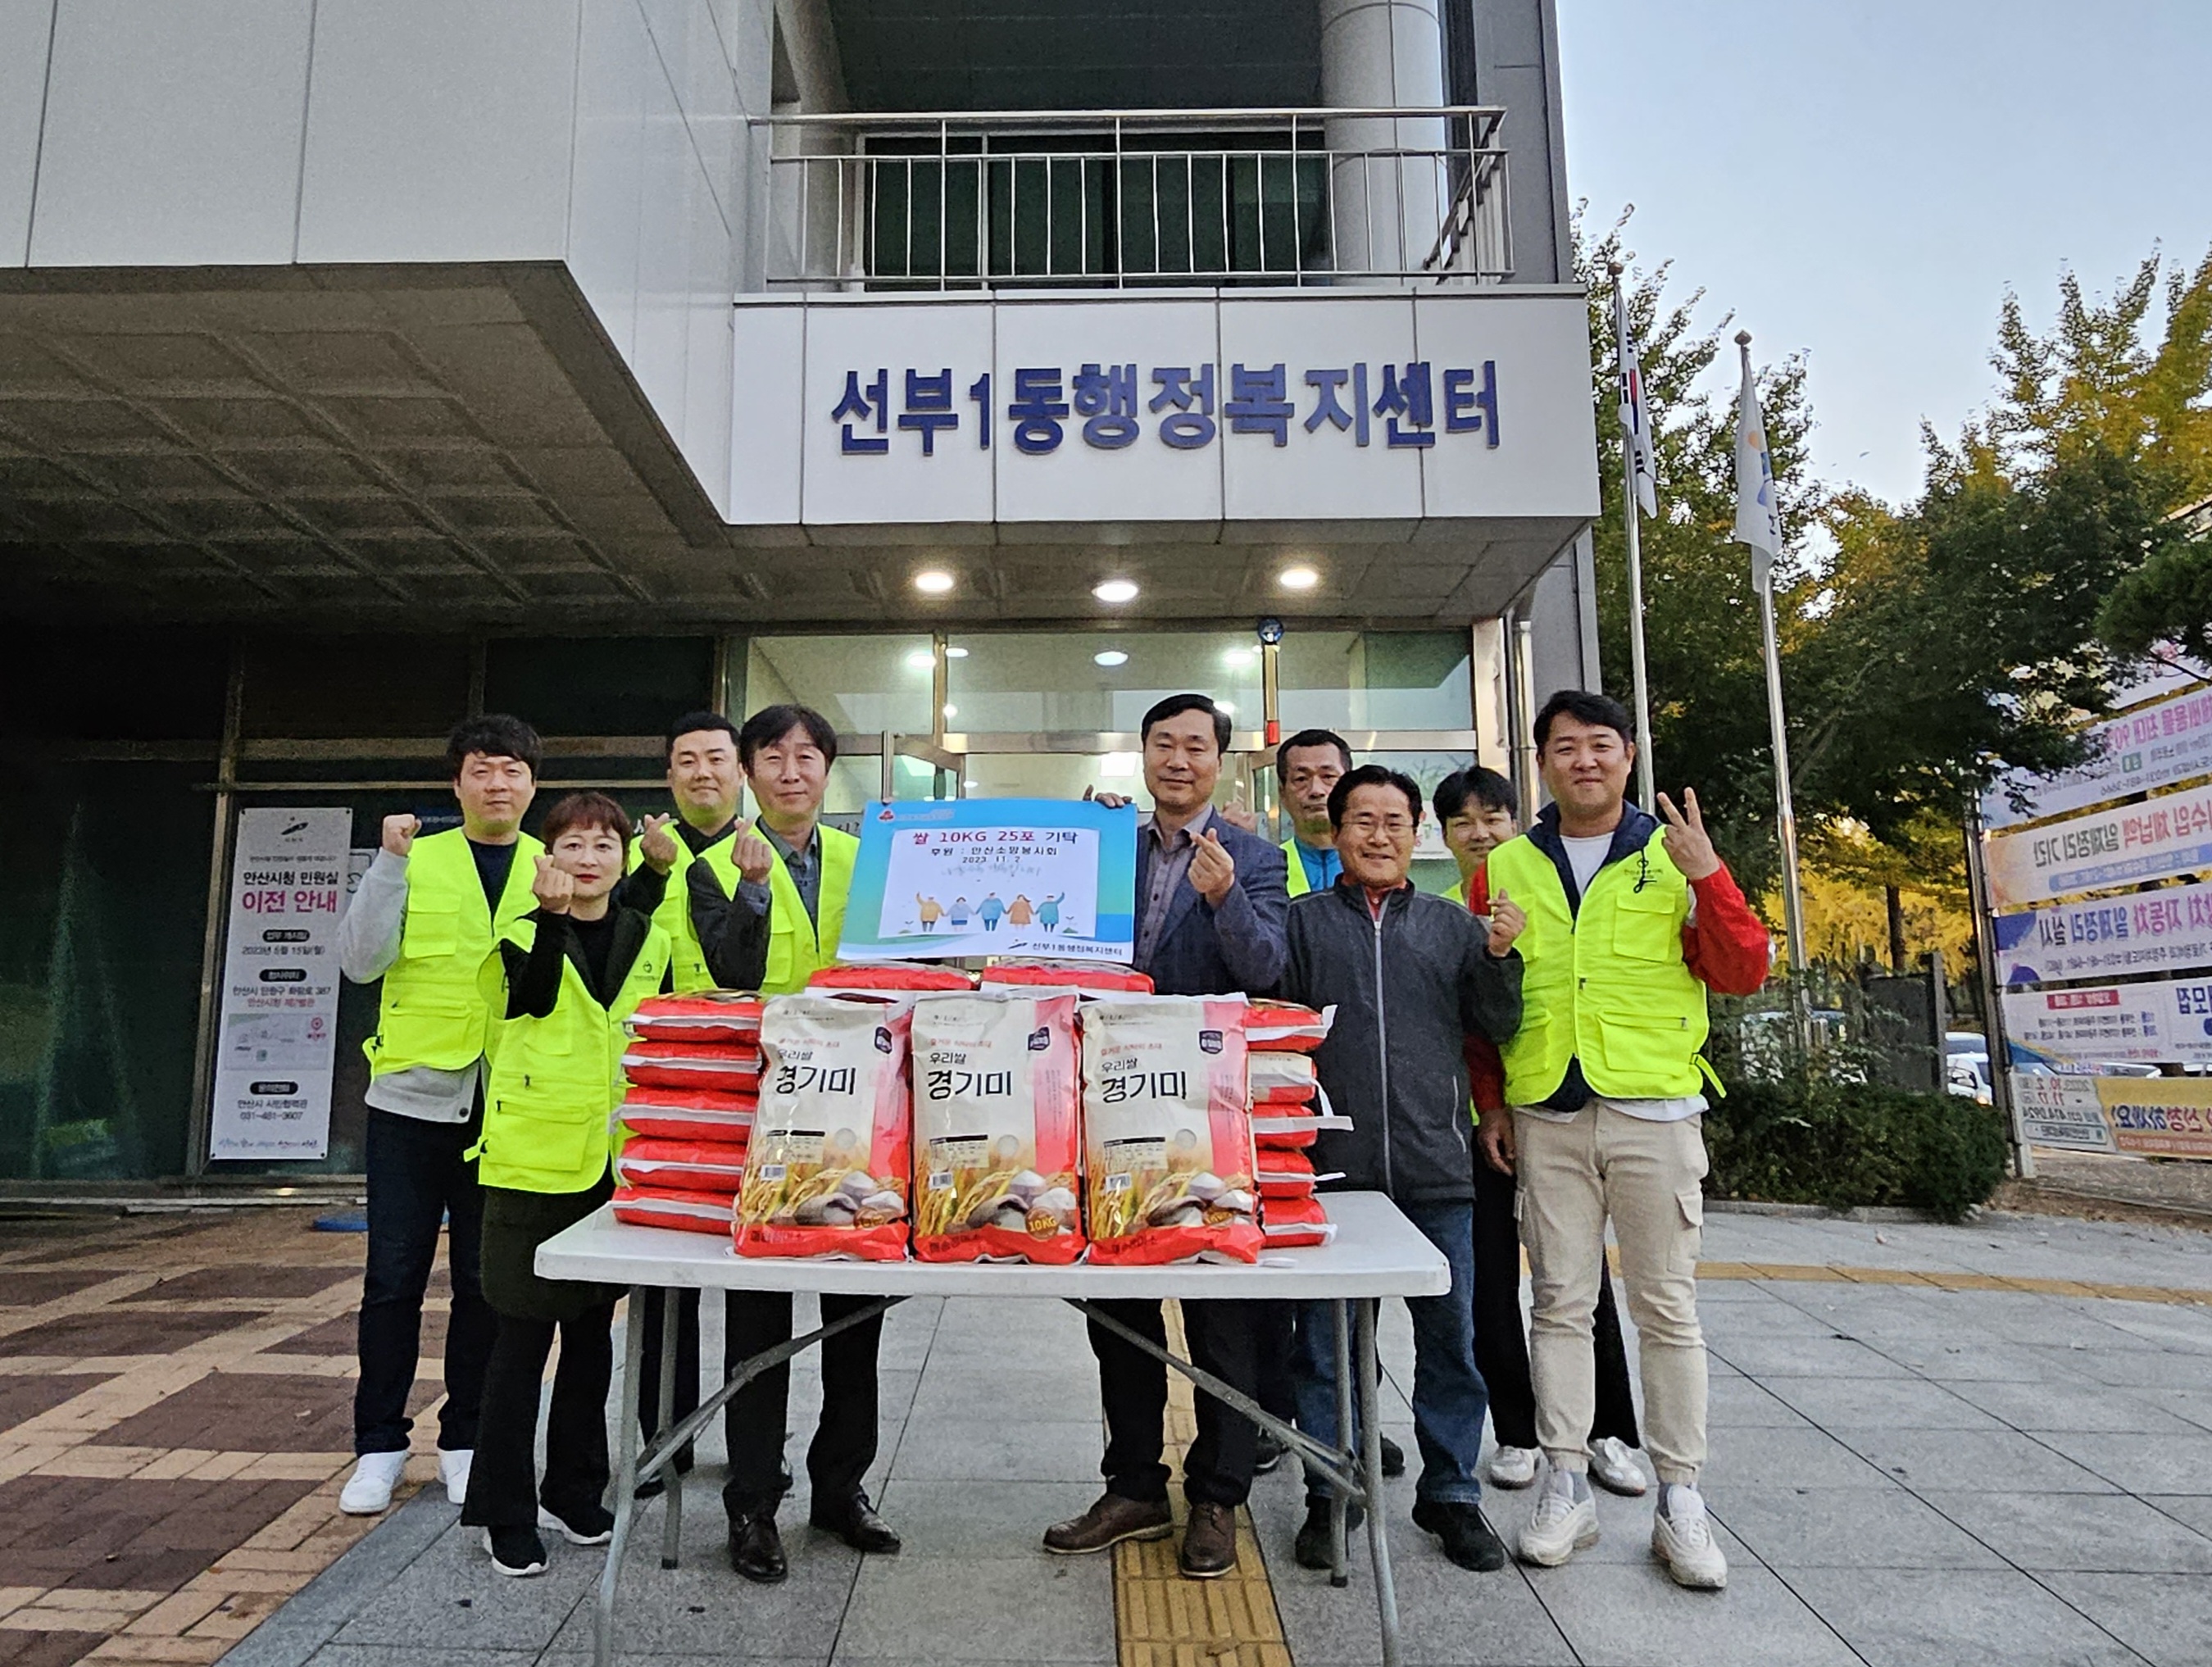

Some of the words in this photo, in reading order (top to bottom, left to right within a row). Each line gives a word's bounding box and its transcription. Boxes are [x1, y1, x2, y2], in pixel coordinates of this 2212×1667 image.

[913, 832, 930, 845] 쌀
[940, 831, 987, 843] 10KG
[997, 830, 1036, 843] 25포
[1045, 831, 1079, 844] 기탁
[243, 871, 295, 885] 안산시청
[300, 871, 339, 885] 민원실
[242, 890, 286, 913] 이전
[293, 890, 338, 913] 안내
[778, 1049, 813, 1061] 우리쌀
[929, 1052, 967, 1065] 우리쌀
[1101, 1057, 1138, 1073] 우리쌀
[776, 1065, 856, 1096] 경기미
[928, 1069, 1011, 1101] 경기미
[1101, 1070, 1187, 1104] 경기미
[1028, 1215, 1057, 1232] 10KG
